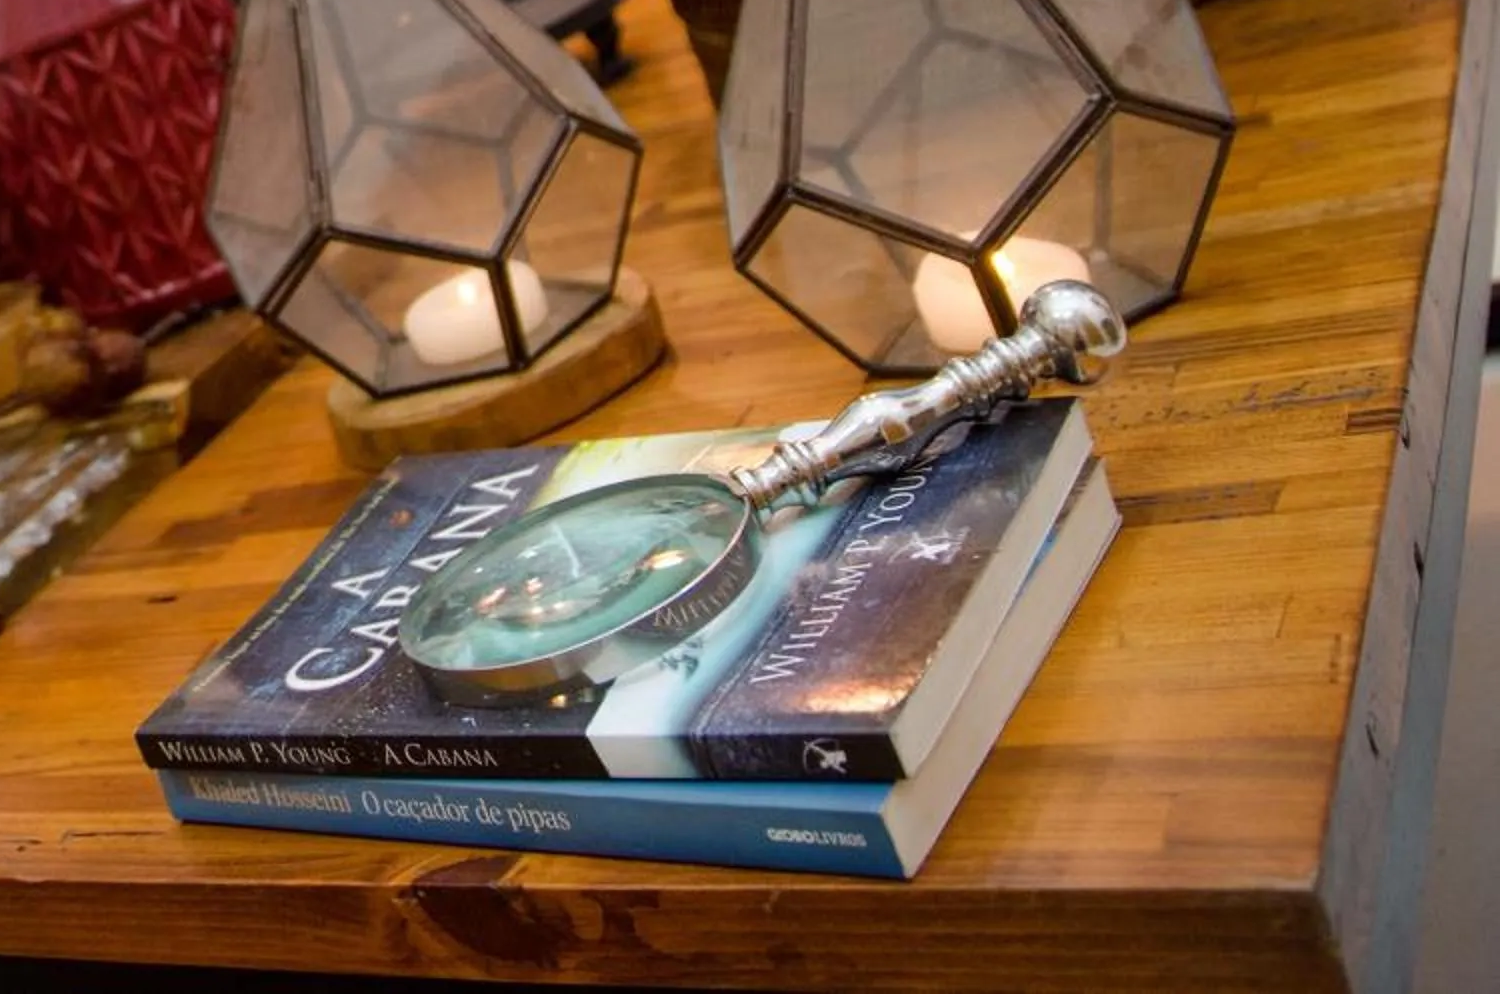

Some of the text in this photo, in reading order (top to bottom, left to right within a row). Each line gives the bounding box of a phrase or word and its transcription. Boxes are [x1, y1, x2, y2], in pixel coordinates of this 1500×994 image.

[284, 463, 540, 692] CABANA
[331, 567, 389, 599] A
[750, 559, 873, 683] WILLIAM
[158, 741, 499, 767] WILLIAM P. YOUNG A CABANA
[361, 790, 381, 815] O
[383, 792, 470, 824] caçador
[475, 797, 501, 826] de
[506, 802, 572, 834] pipas
